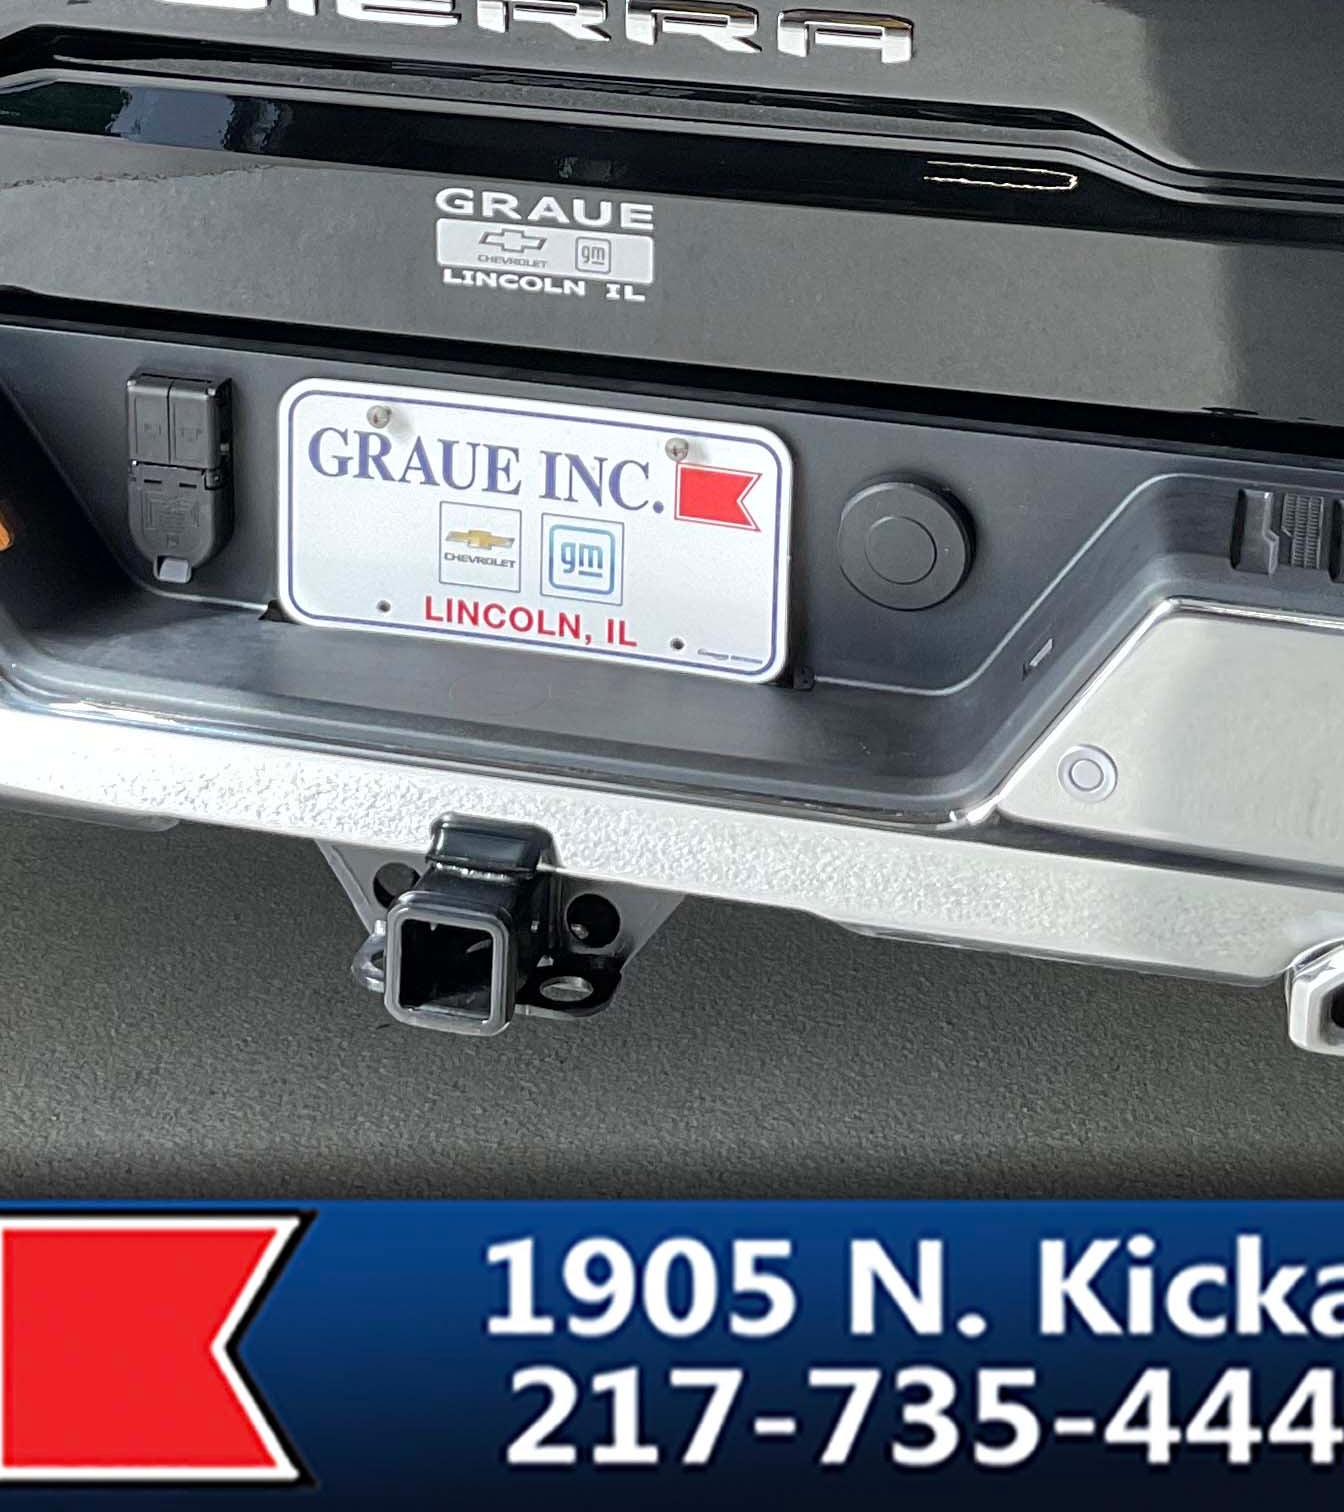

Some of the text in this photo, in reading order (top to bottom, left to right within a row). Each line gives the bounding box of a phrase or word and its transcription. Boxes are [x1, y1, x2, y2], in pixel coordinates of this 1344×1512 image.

[435, 187, 654, 230] GRAUE
[477, 253, 548, 268] CHEVROLET
[443, 268, 646, 302] LINCOLN IL
[308, 427, 664, 514] GRAUE INC.
[444, 552, 516, 569] CHEVROLET
[560, 541, 604, 578] gm
[425, 596, 638, 648] LINCOLN, IL
